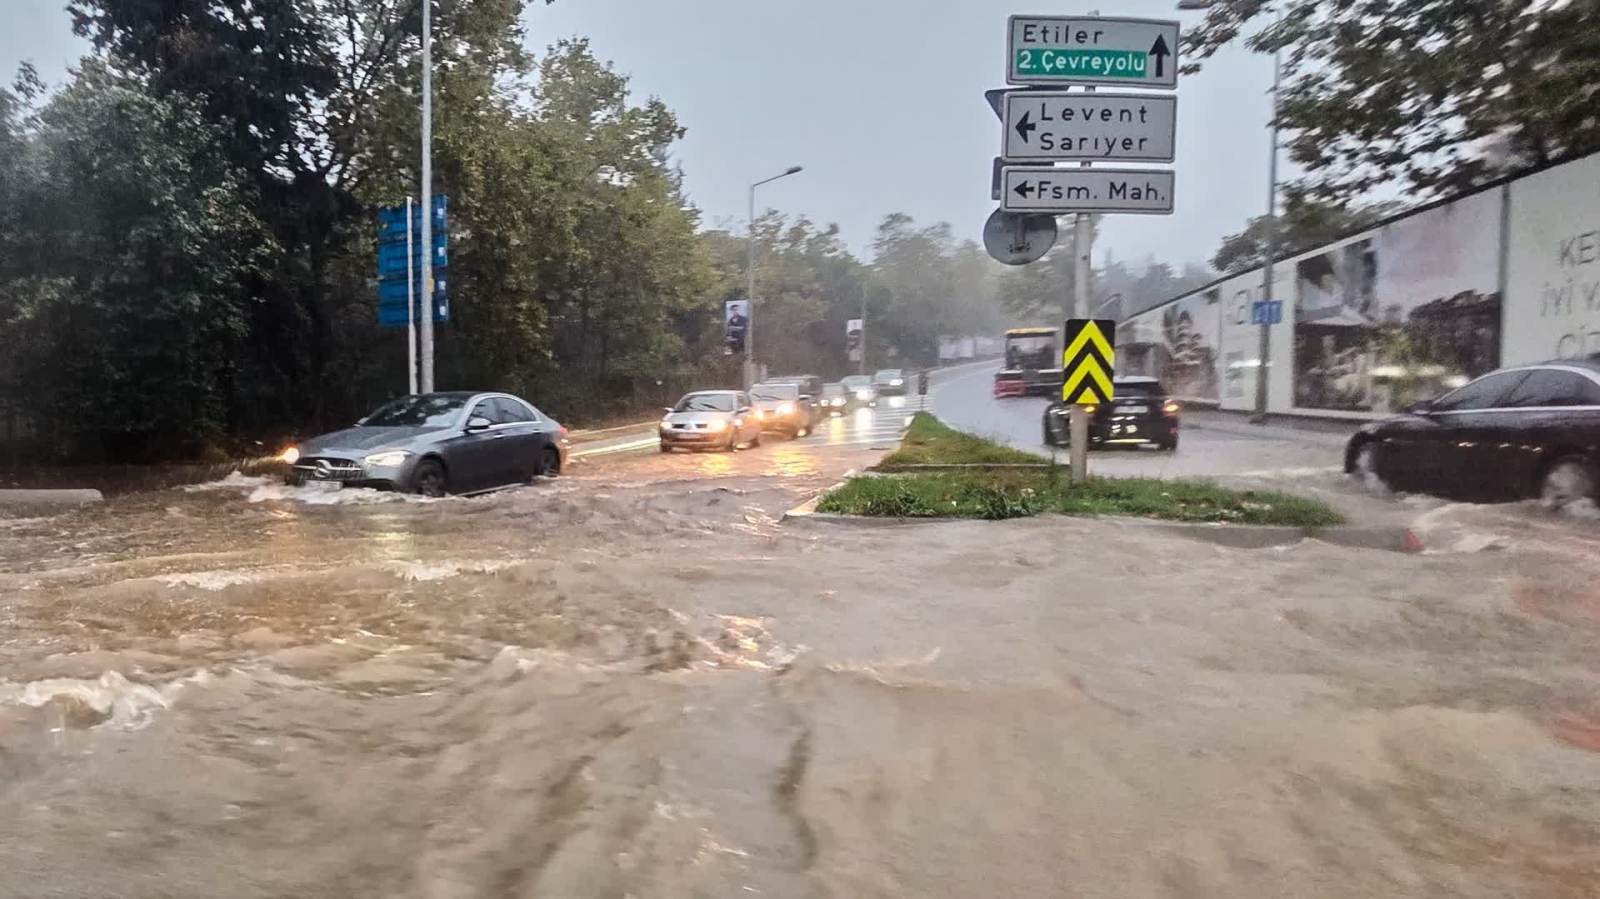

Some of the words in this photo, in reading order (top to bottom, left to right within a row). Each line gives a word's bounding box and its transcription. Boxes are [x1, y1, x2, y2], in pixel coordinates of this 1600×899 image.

[1023, 24, 1104, 44] Etiler
[1018, 50, 1037, 70] 2.
[1041, 52, 1145, 75] Çevreyolu
[1040, 102, 1148, 123] Levent
[1040, 132, 1148, 156] Sarıyer
[1037, 181, 1098, 200] Fsm.
[1108, 181, 1166, 201] Mah.
